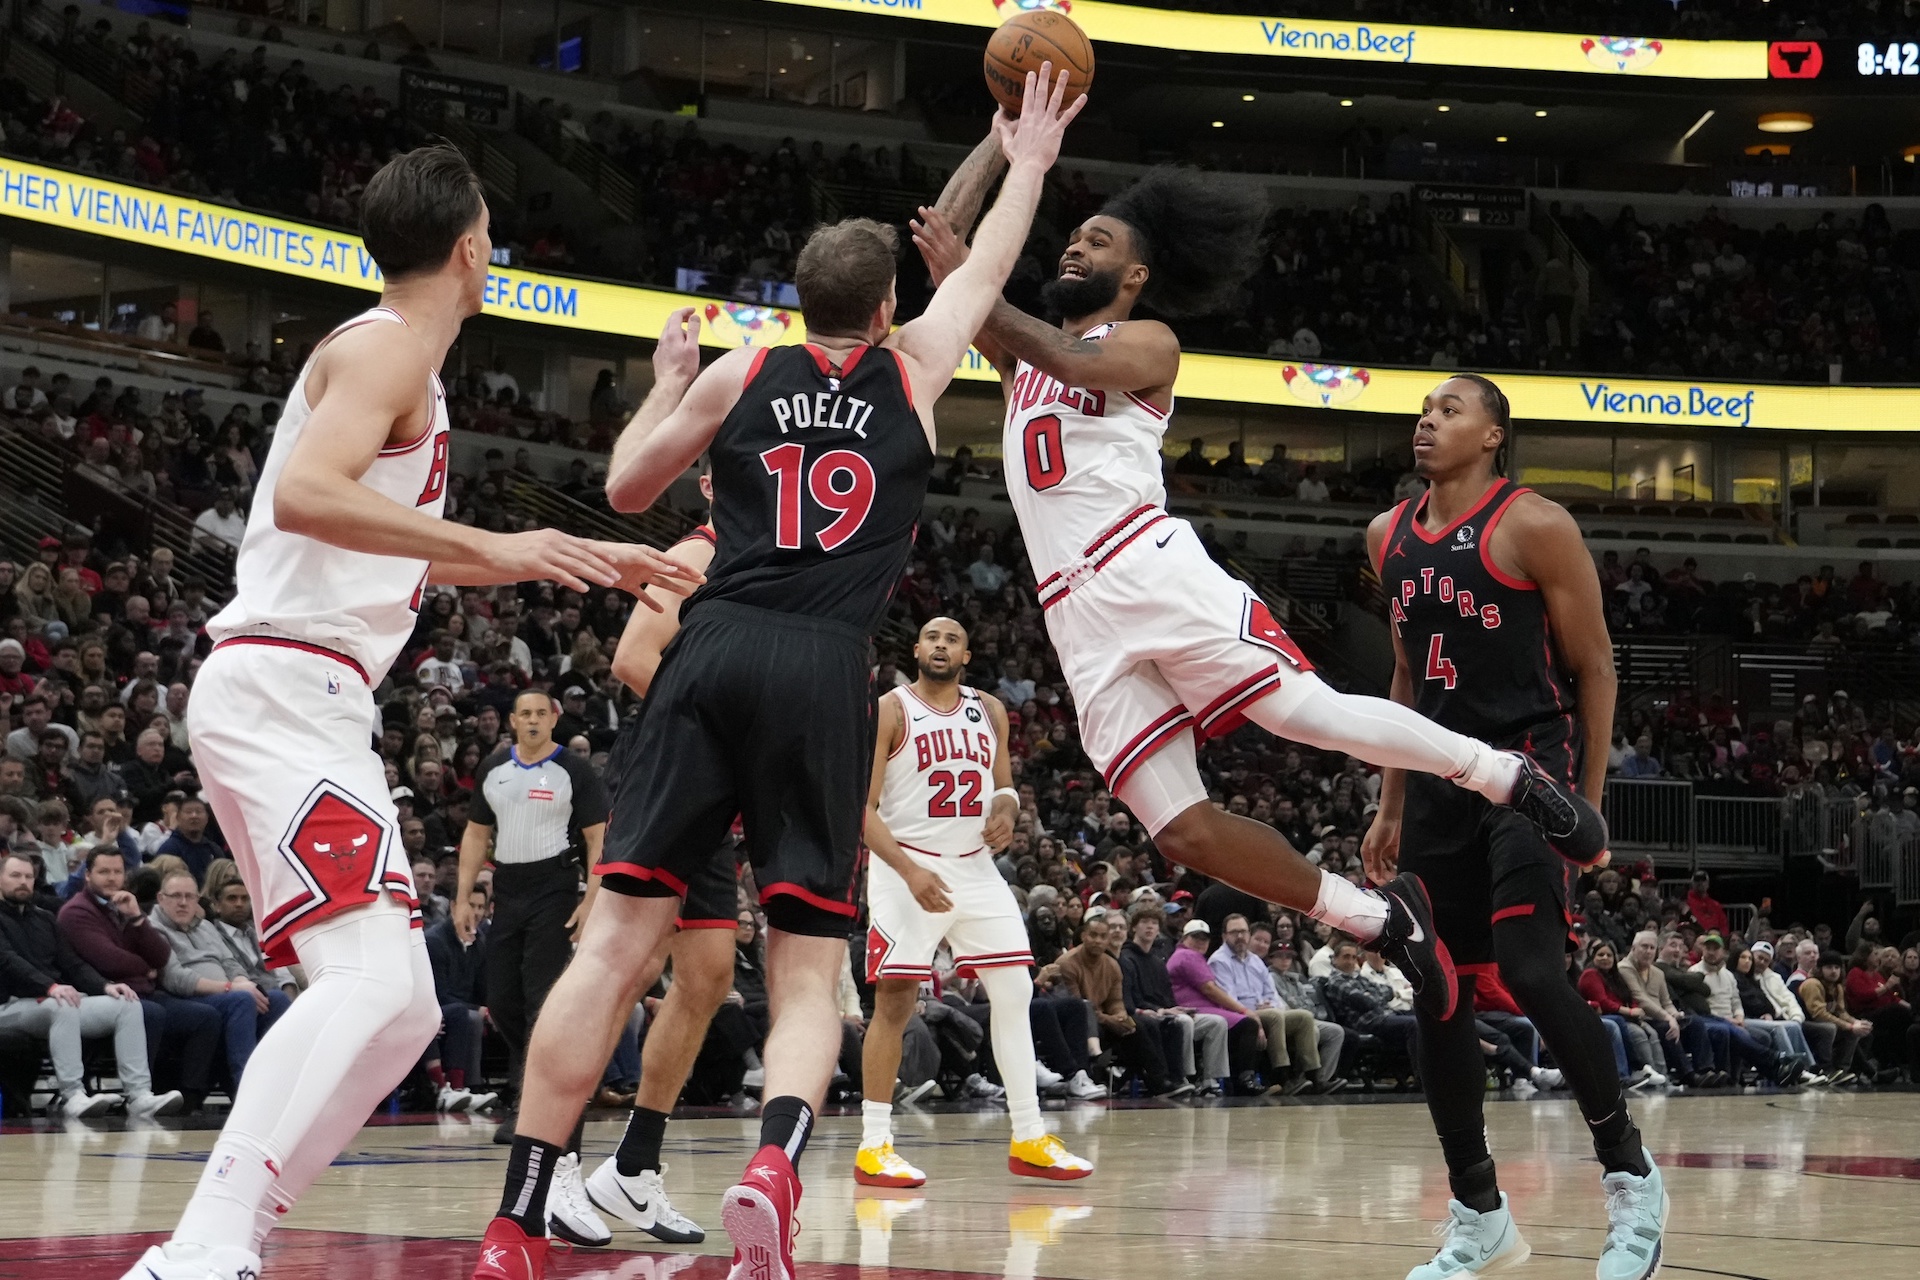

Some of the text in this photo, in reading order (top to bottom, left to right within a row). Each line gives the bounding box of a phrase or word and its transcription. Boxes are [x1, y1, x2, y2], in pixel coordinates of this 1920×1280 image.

[1260, 20, 1415, 63] Vienna Beef
[1856, 42, 1920, 76] 8:42
[0, 168, 60, 212] HER
[68, 184, 169, 236] VIENNA
[177, 208, 314, 267] FAVORITES
[321, 240, 352, 273] AT
[770, 391, 875, 440] POELTL
[1580, 381, 1755, 428] Vienna Beef
[1022, 413, 1067, 493] 0
[759, 442, 876, 552] 19
[1390, 567, 1502, 638] APTORS
[1425, 633, 1458, 690] 4
[914, 728, 991, 773] BULLS
[928, 770, 983, 817] 22
